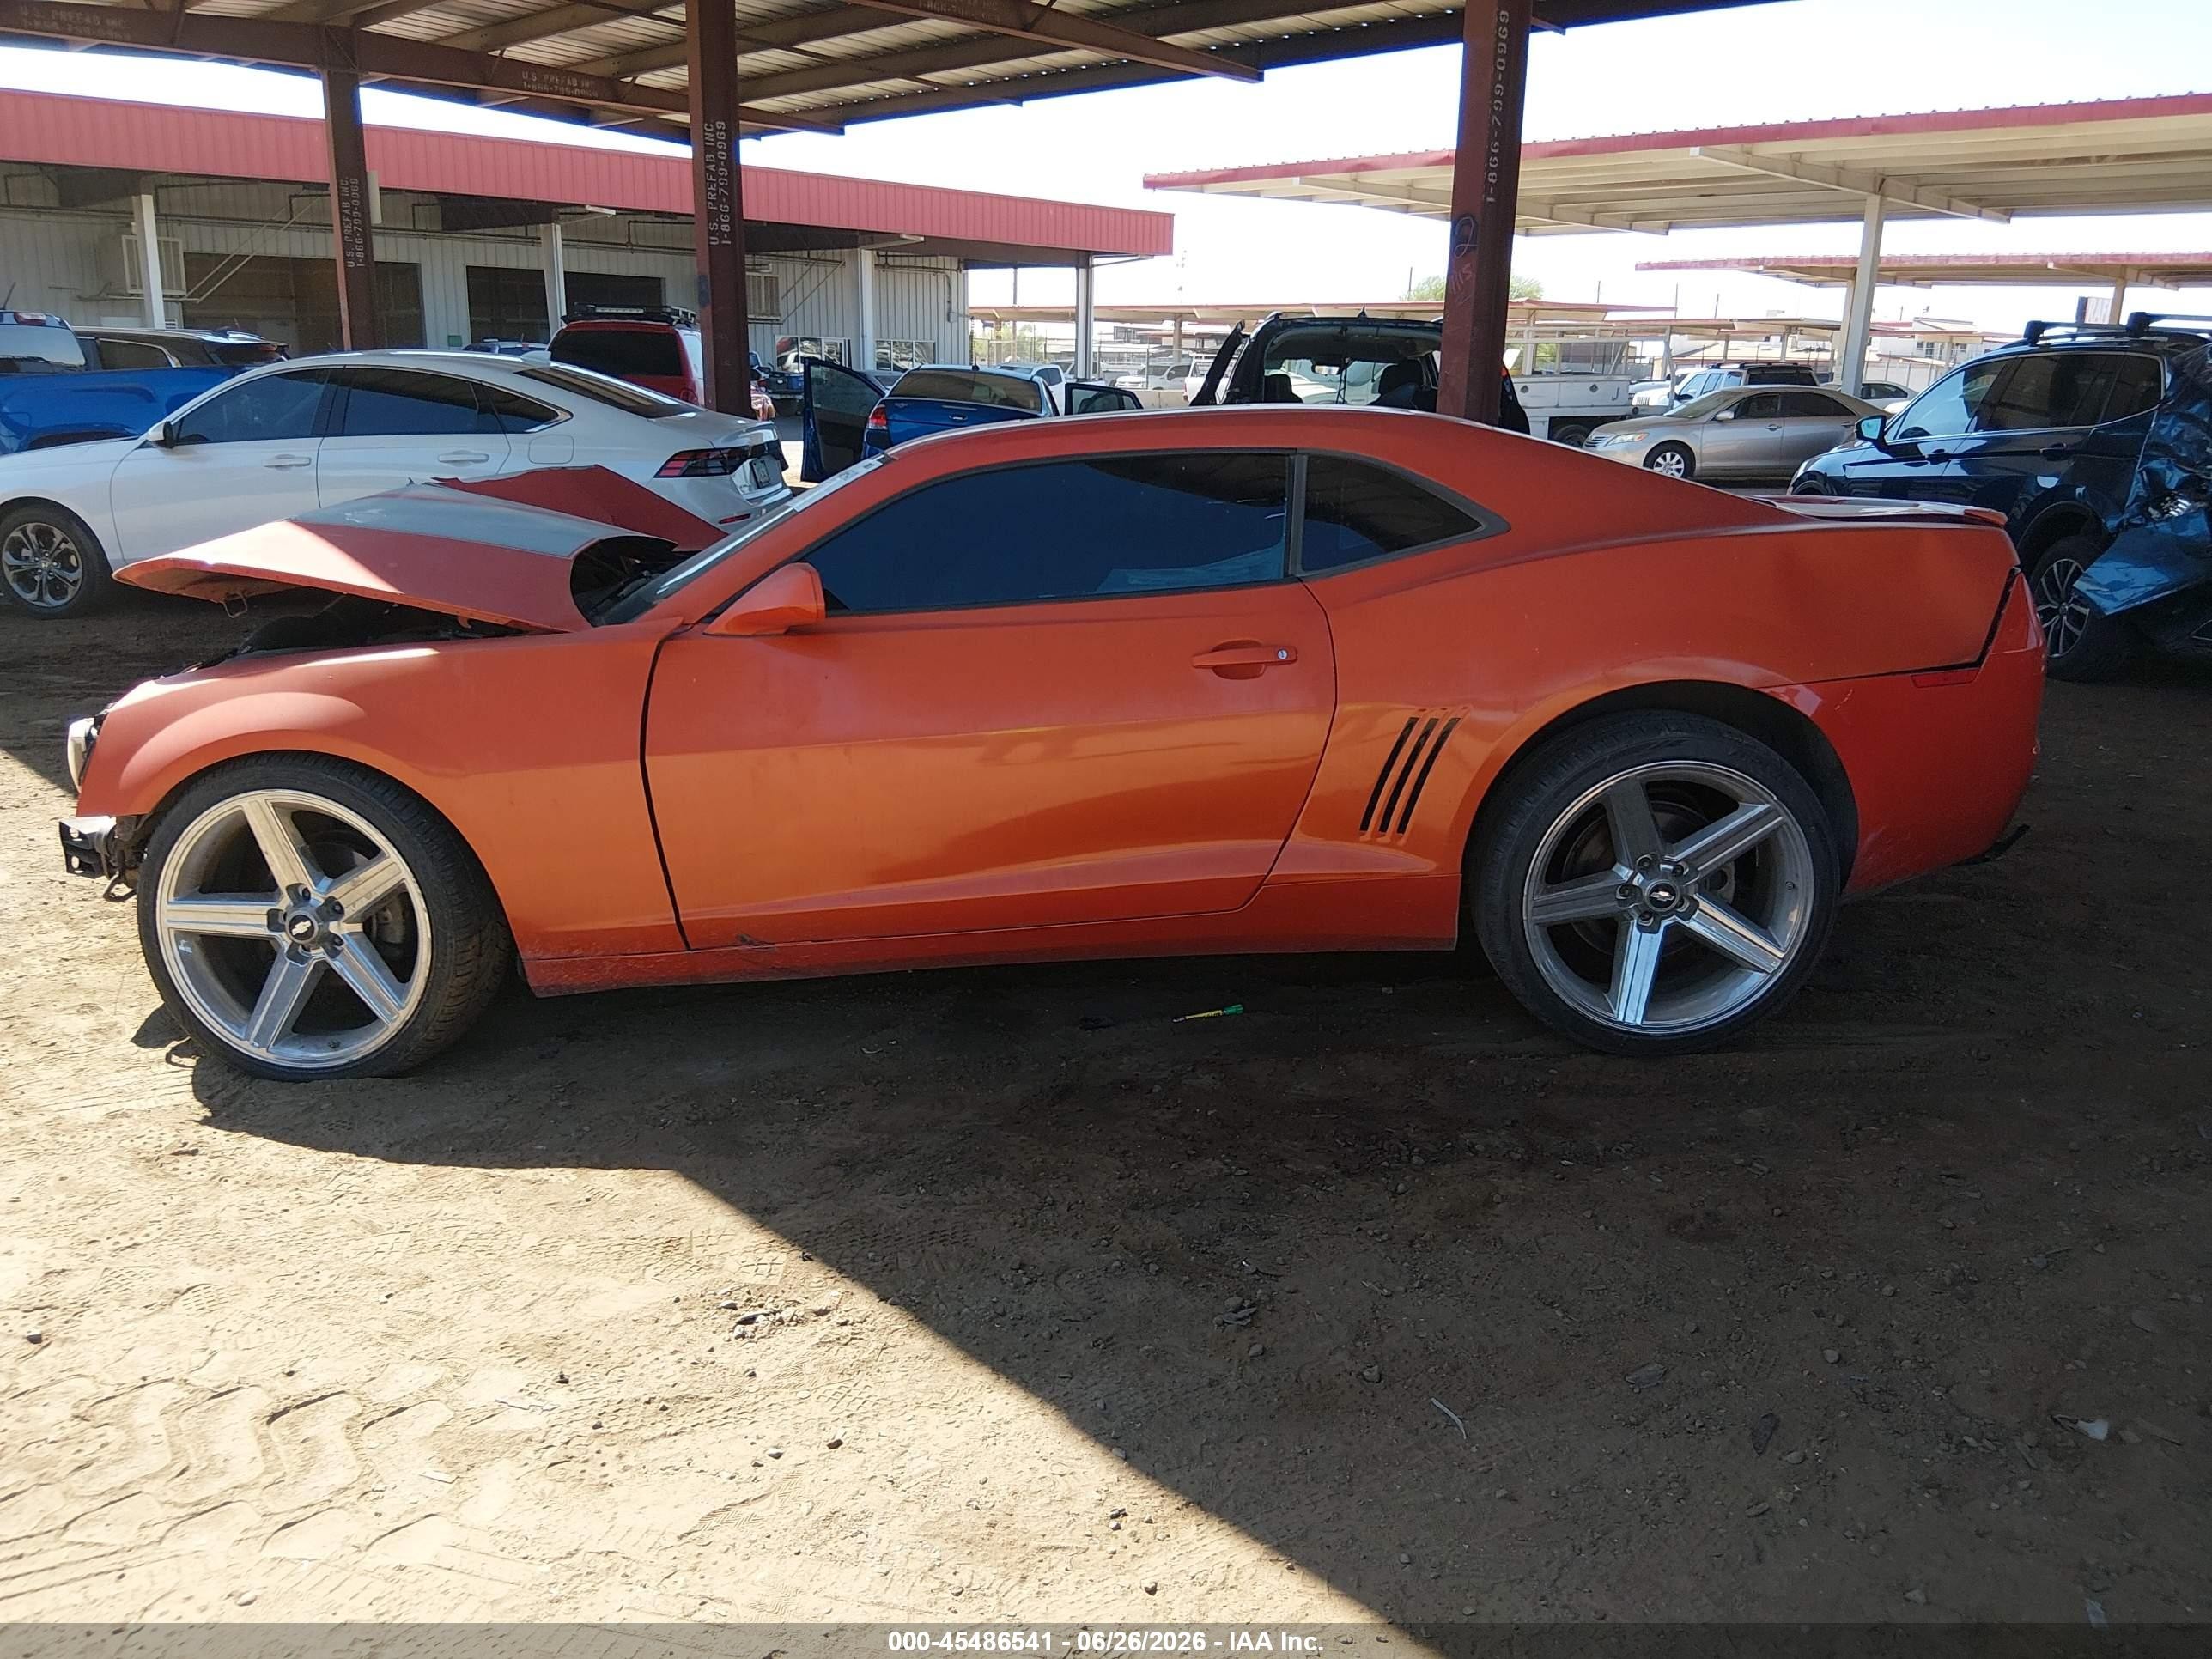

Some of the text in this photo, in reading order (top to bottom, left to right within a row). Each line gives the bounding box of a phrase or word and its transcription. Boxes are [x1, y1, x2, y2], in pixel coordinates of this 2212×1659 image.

[1486, 9, 1510, 204] 1-866-799-0969
[343, 201, 353, 242] PREFAB
[704, 154, 718, 211] PREFAB
[715, 120, 732, 246] 1-866-799-0969
